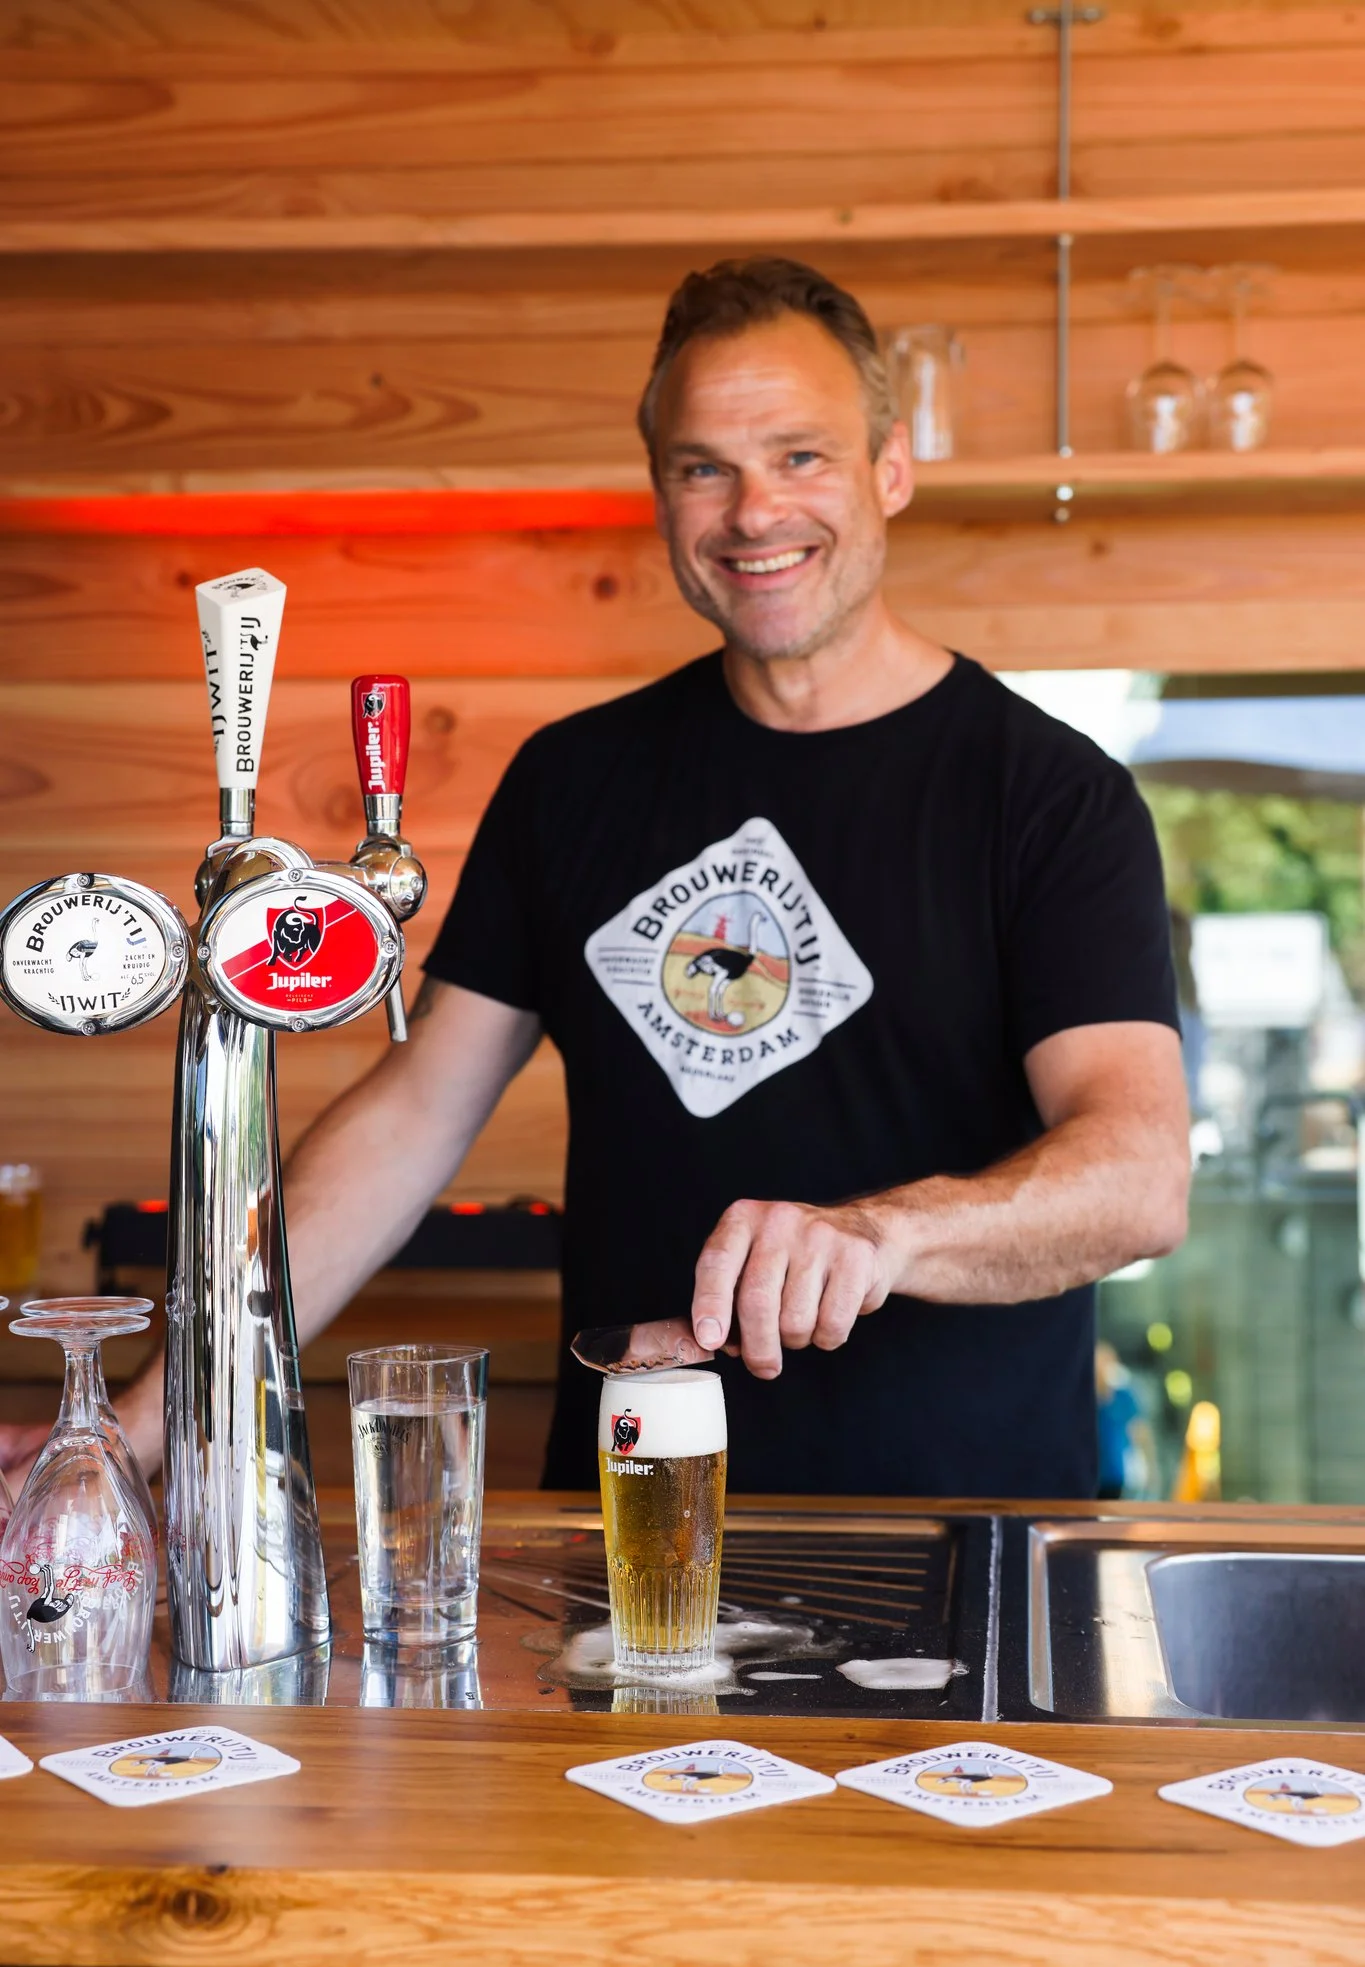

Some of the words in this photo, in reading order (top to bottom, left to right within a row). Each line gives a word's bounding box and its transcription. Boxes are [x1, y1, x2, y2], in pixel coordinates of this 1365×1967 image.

[124, 953, 146, 962] ZACHT
[12, 958, 53, 967] ONVERWACHT
[122, 961, 151, 970] KRUIDIG
[23, 967, 55, 975] KRACHTIG
[59, 991, 123, 1014] IJWIT
[638, 1000, 801, 1066] AMSTERDAM
